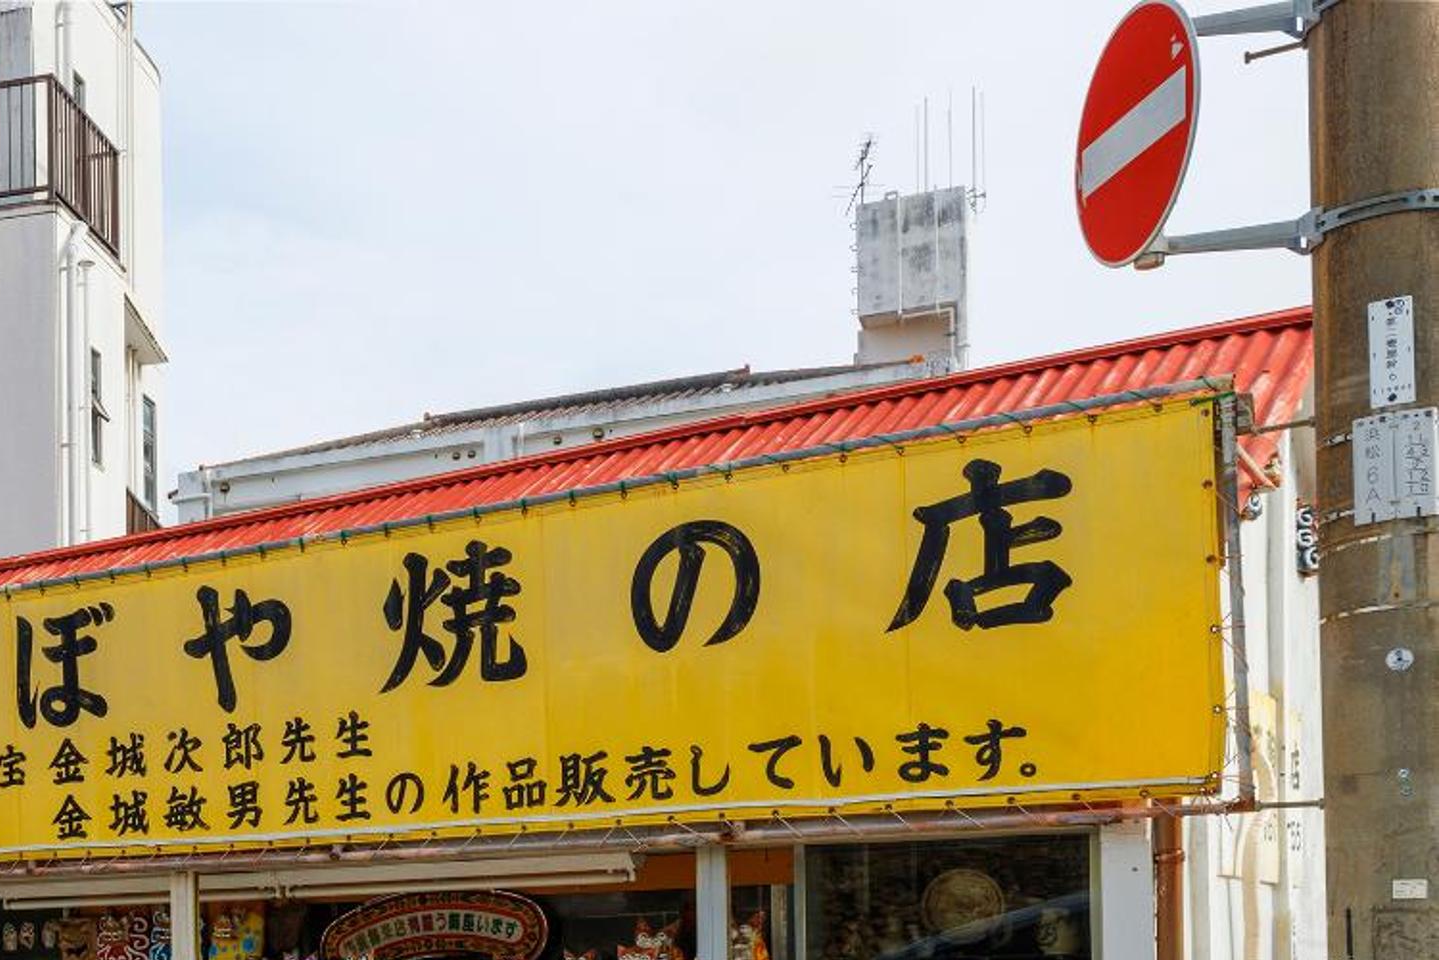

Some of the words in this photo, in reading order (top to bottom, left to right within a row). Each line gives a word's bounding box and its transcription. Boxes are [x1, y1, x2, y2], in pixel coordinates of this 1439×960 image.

[51, 718, 1038, 841] 金城敏男先生の作品販売しています。
